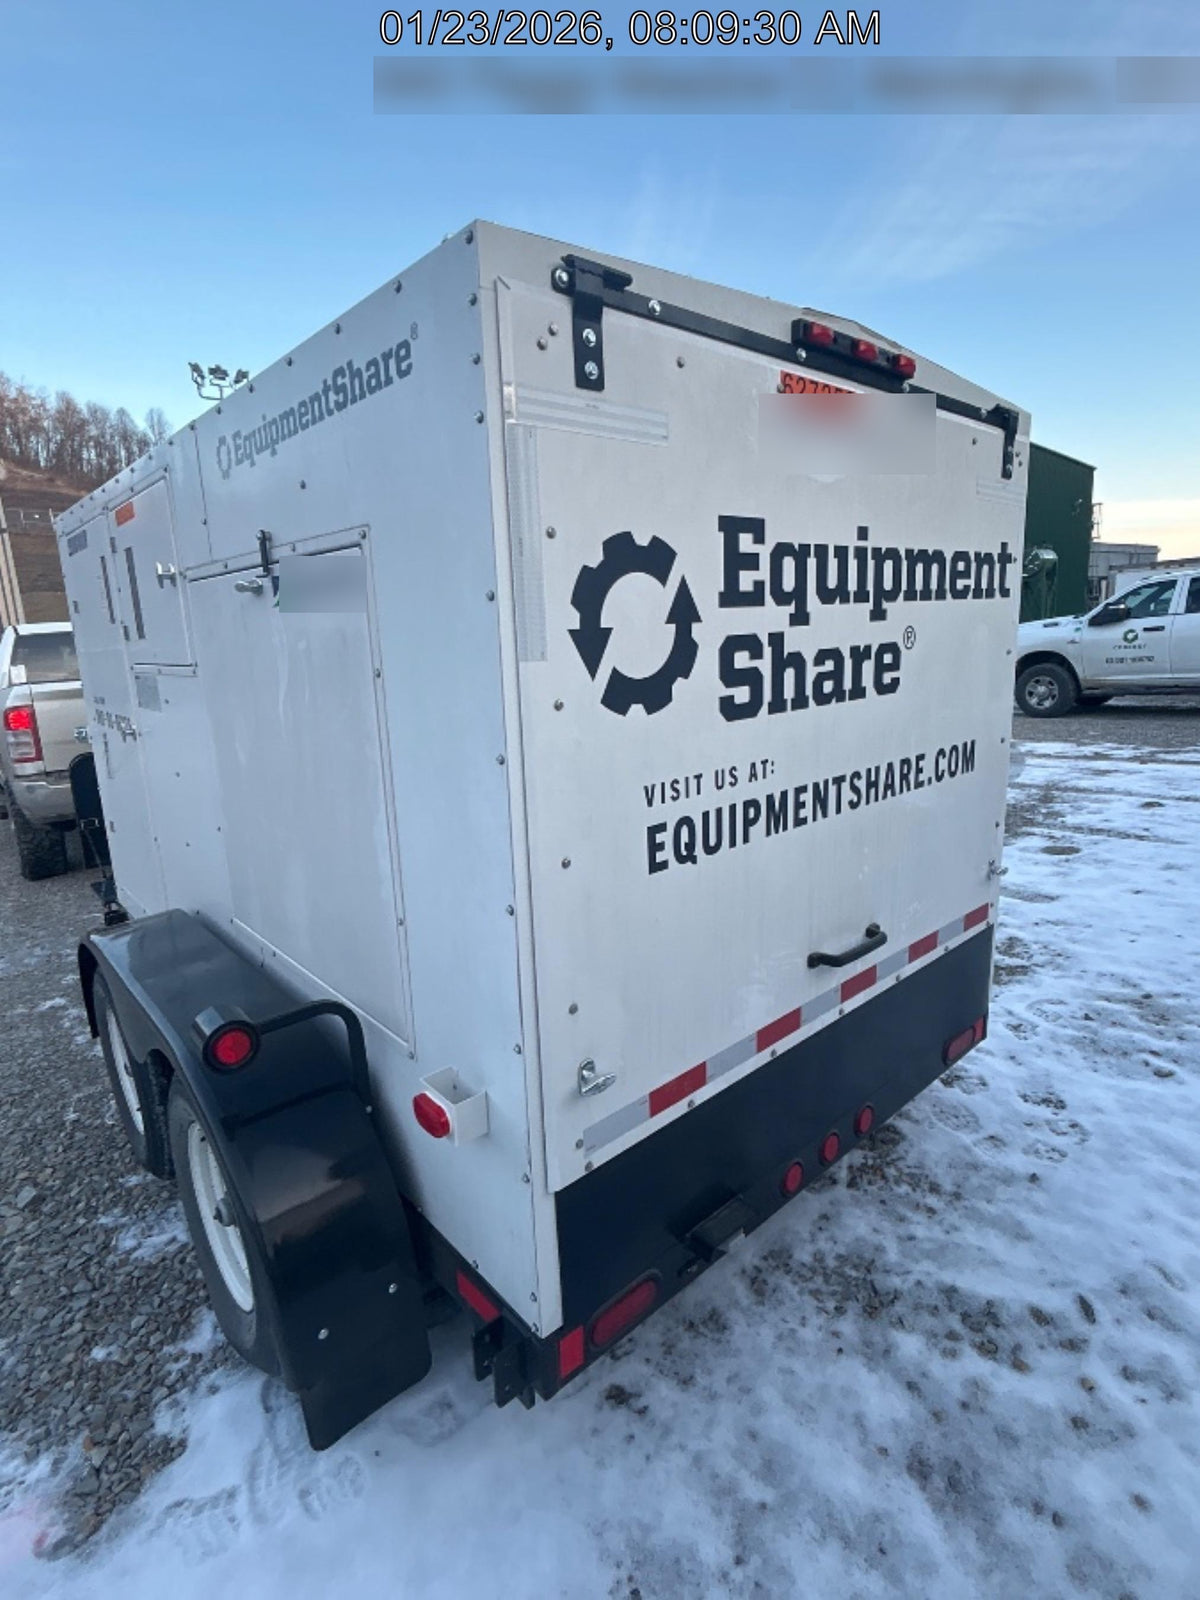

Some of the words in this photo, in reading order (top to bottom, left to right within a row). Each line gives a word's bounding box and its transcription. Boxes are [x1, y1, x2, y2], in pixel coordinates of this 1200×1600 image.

[717, 514, 1013, 627] Equipment
[643, 772, 703, 808] VISIT
[714, 765, 739, 791] US
[748, 758, 775, 783] AT:
[646, 739, 977, 875] EQUIPMENTSHARE.COM
